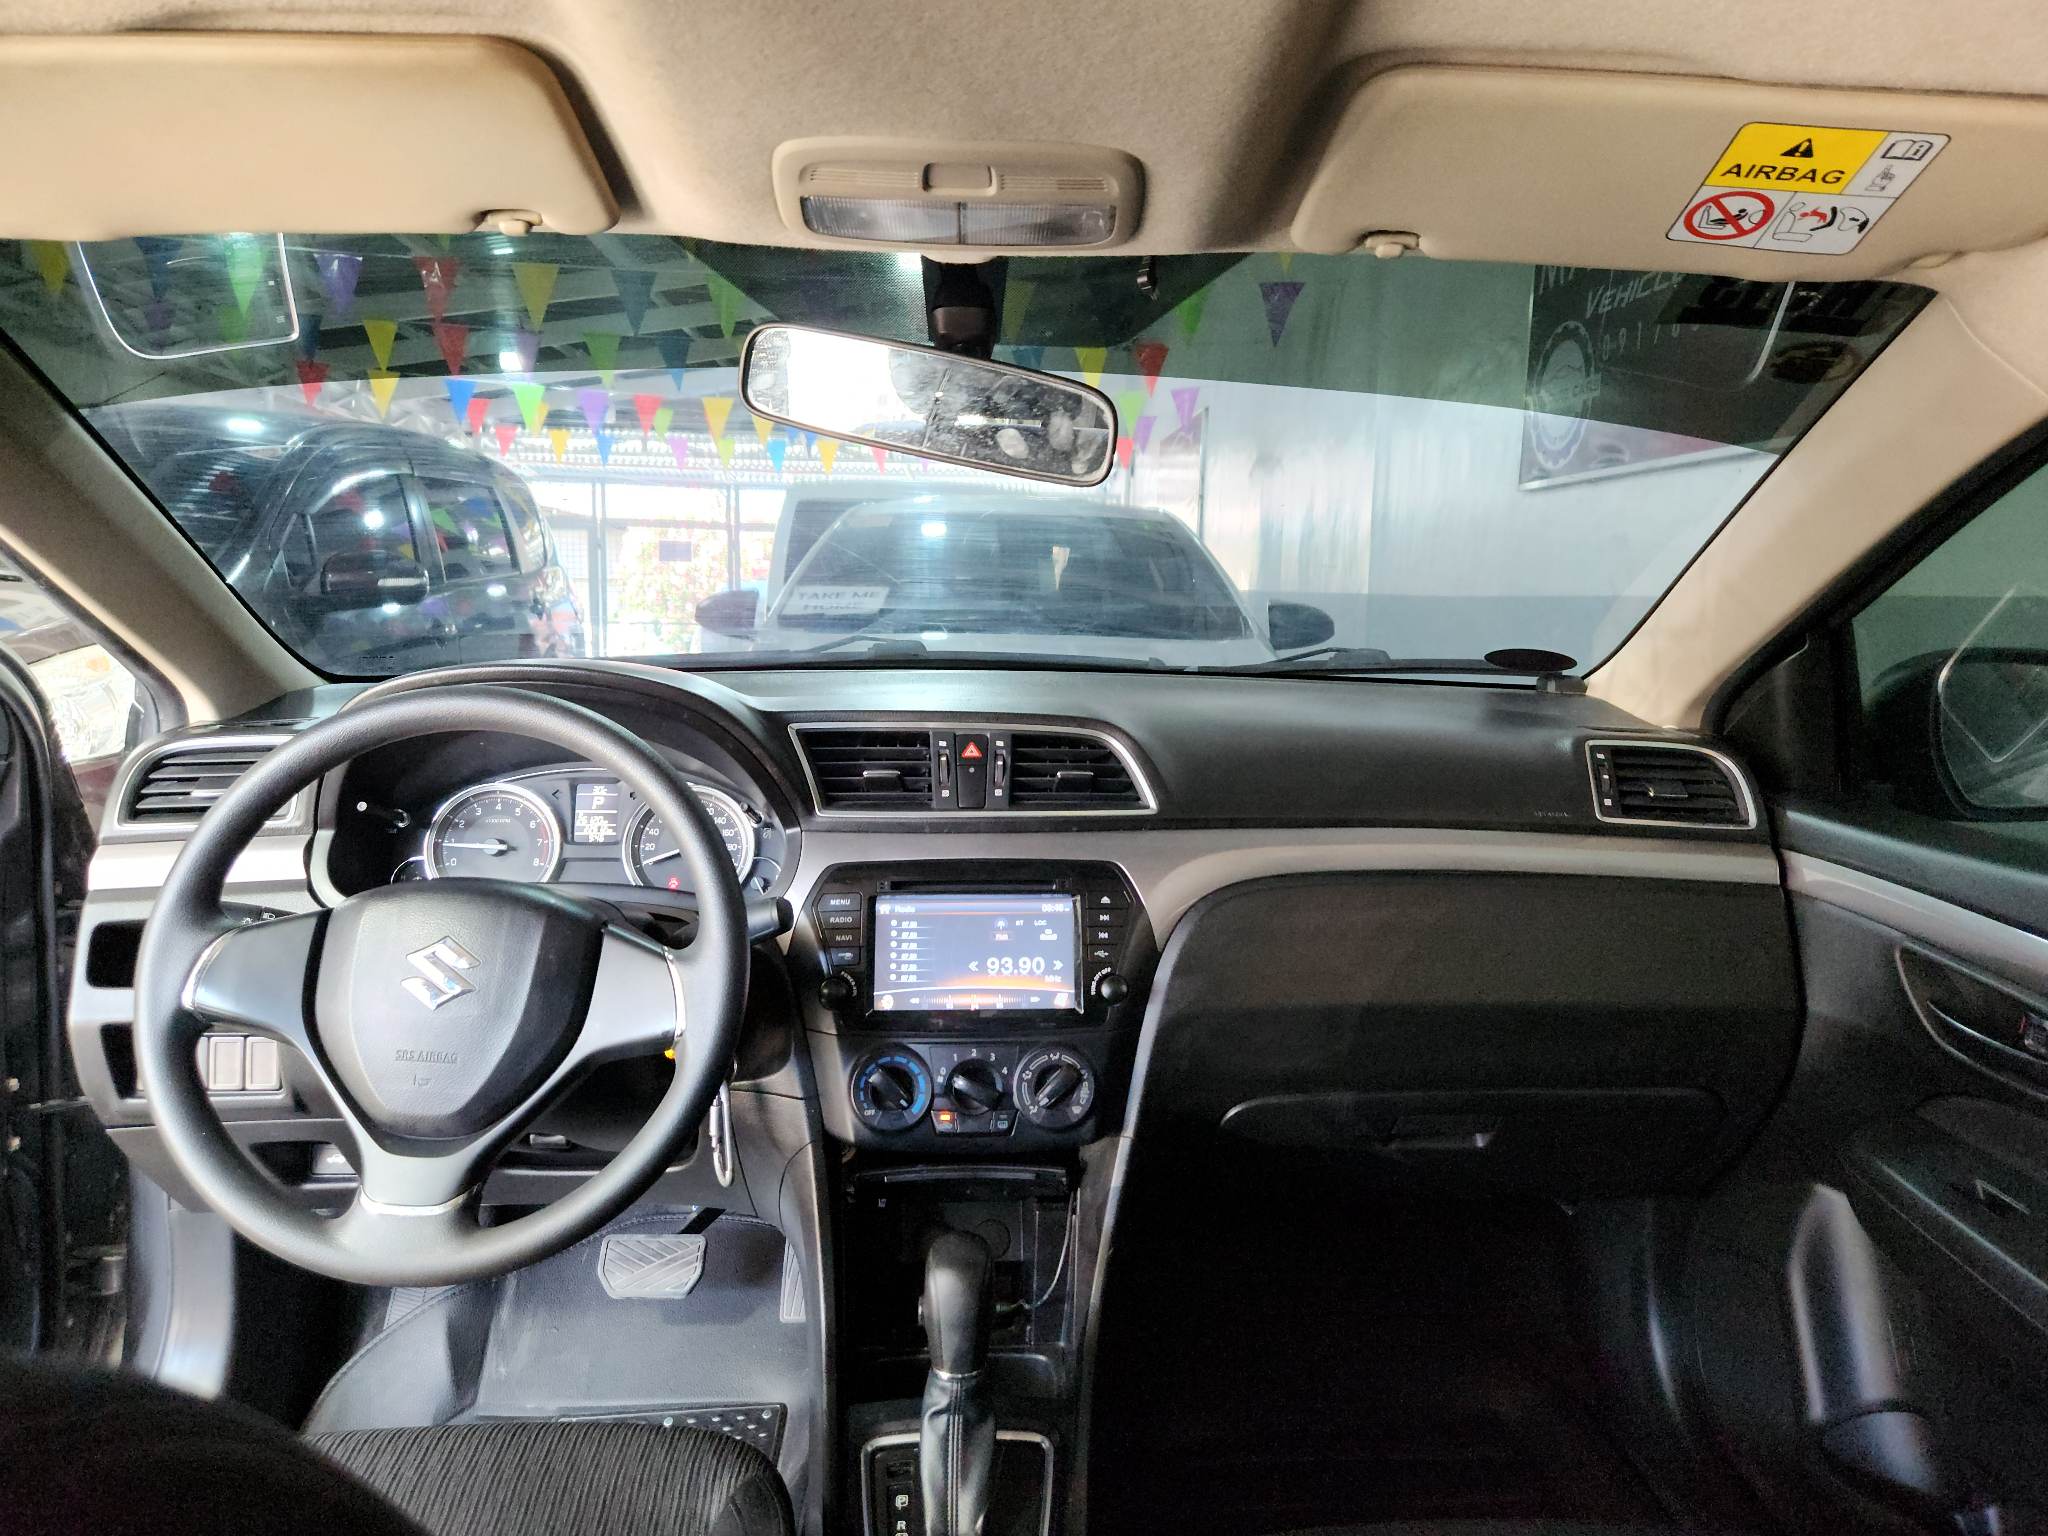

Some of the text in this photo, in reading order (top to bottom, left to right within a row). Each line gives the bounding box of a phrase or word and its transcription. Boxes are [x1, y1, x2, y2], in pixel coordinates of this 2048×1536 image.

[1720, 163, 1845, 185] AIRBAG
[986, 957, 1046, 976] 93.90
[971, 1049, 977, 1057] 2
[990, 1052, 996, 1062] 3
[1002, 1066, 1008, 1075] 4
